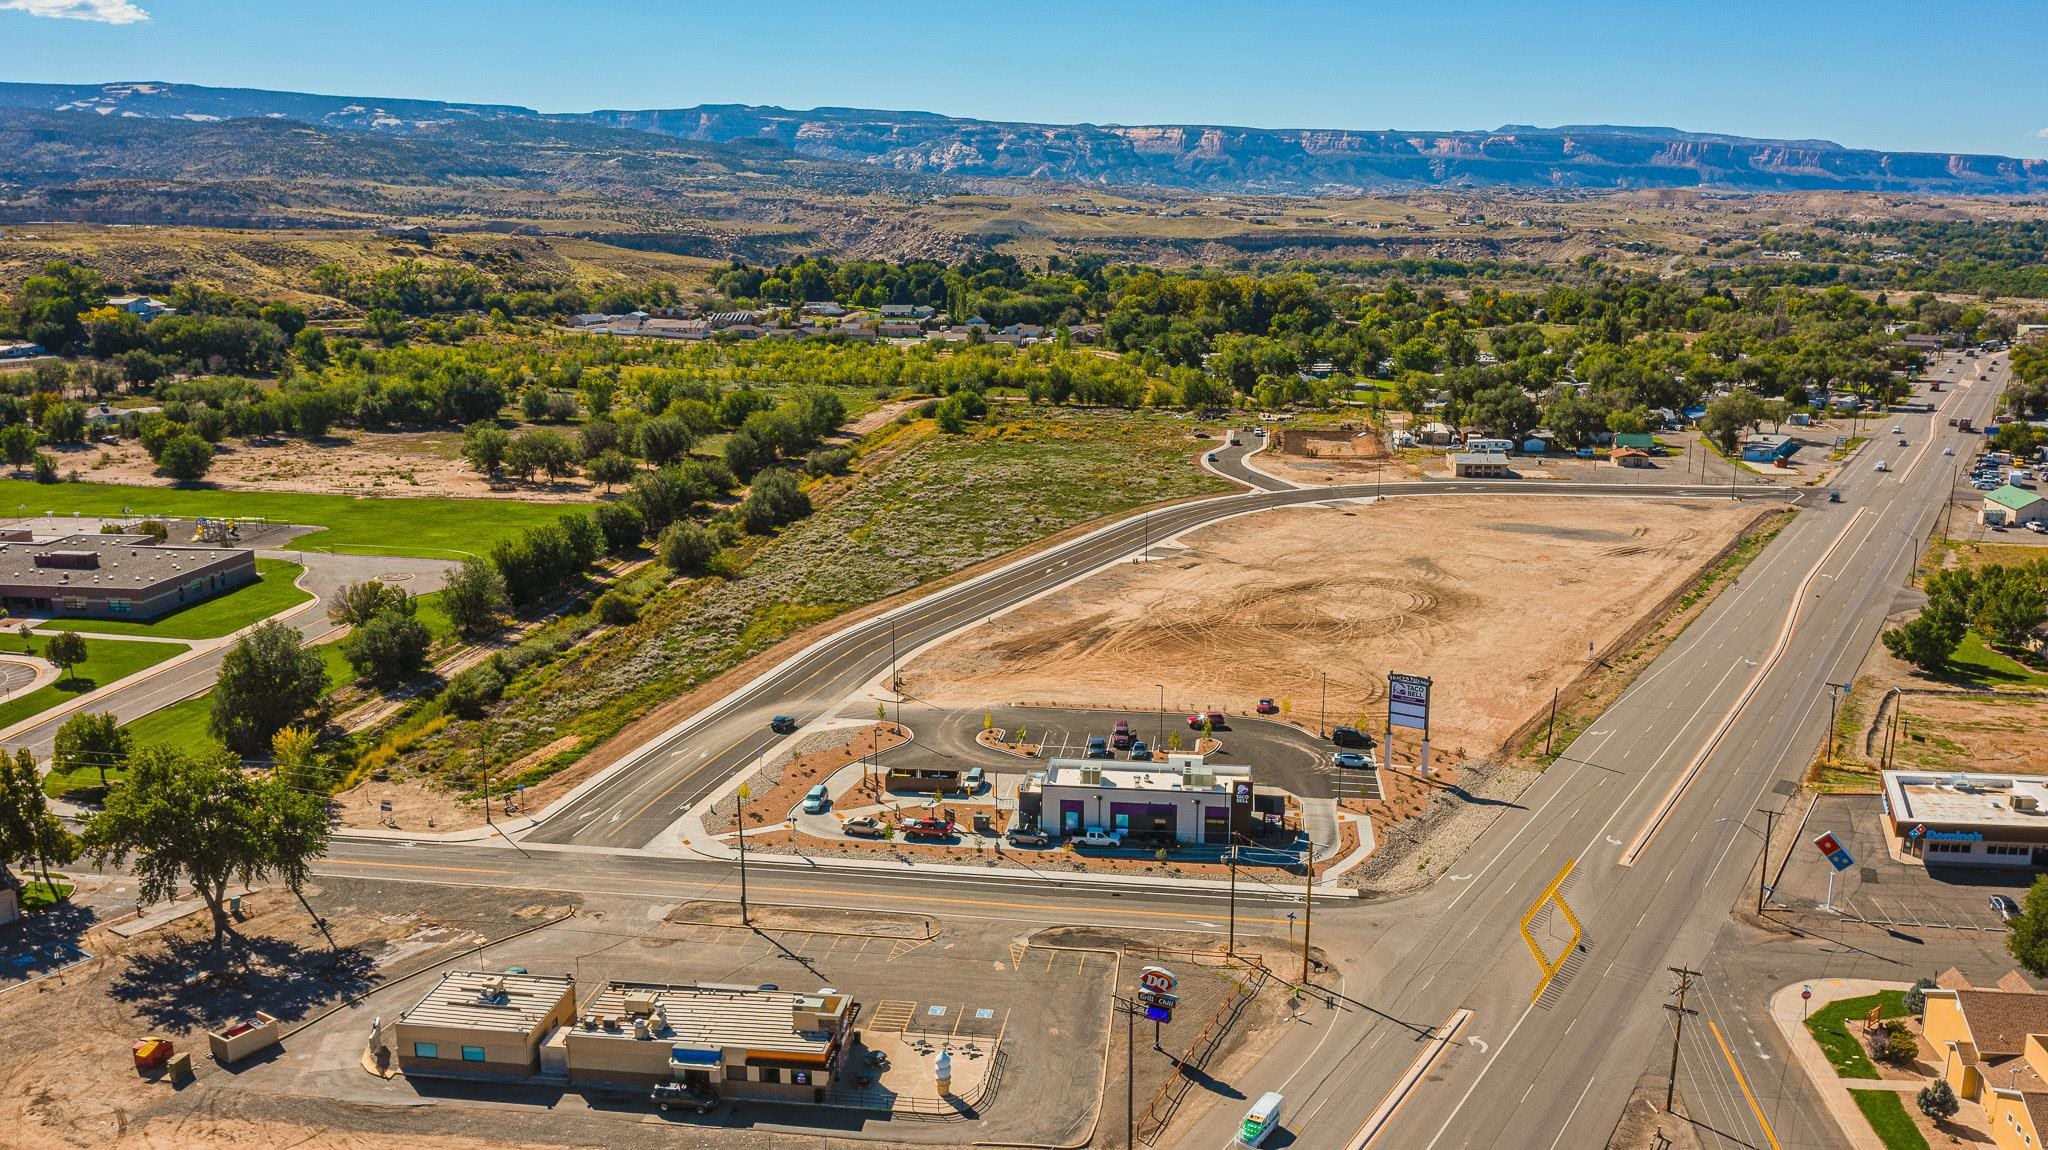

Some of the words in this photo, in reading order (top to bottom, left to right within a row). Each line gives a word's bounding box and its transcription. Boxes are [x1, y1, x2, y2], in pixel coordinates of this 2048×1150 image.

[1406, 684, 1424, 693] TACO
[1407, 691, 1424, 699] BELL
[1926, 830, 1984, 841] Domino's
[1146, 974, 1169, 990] DQ
